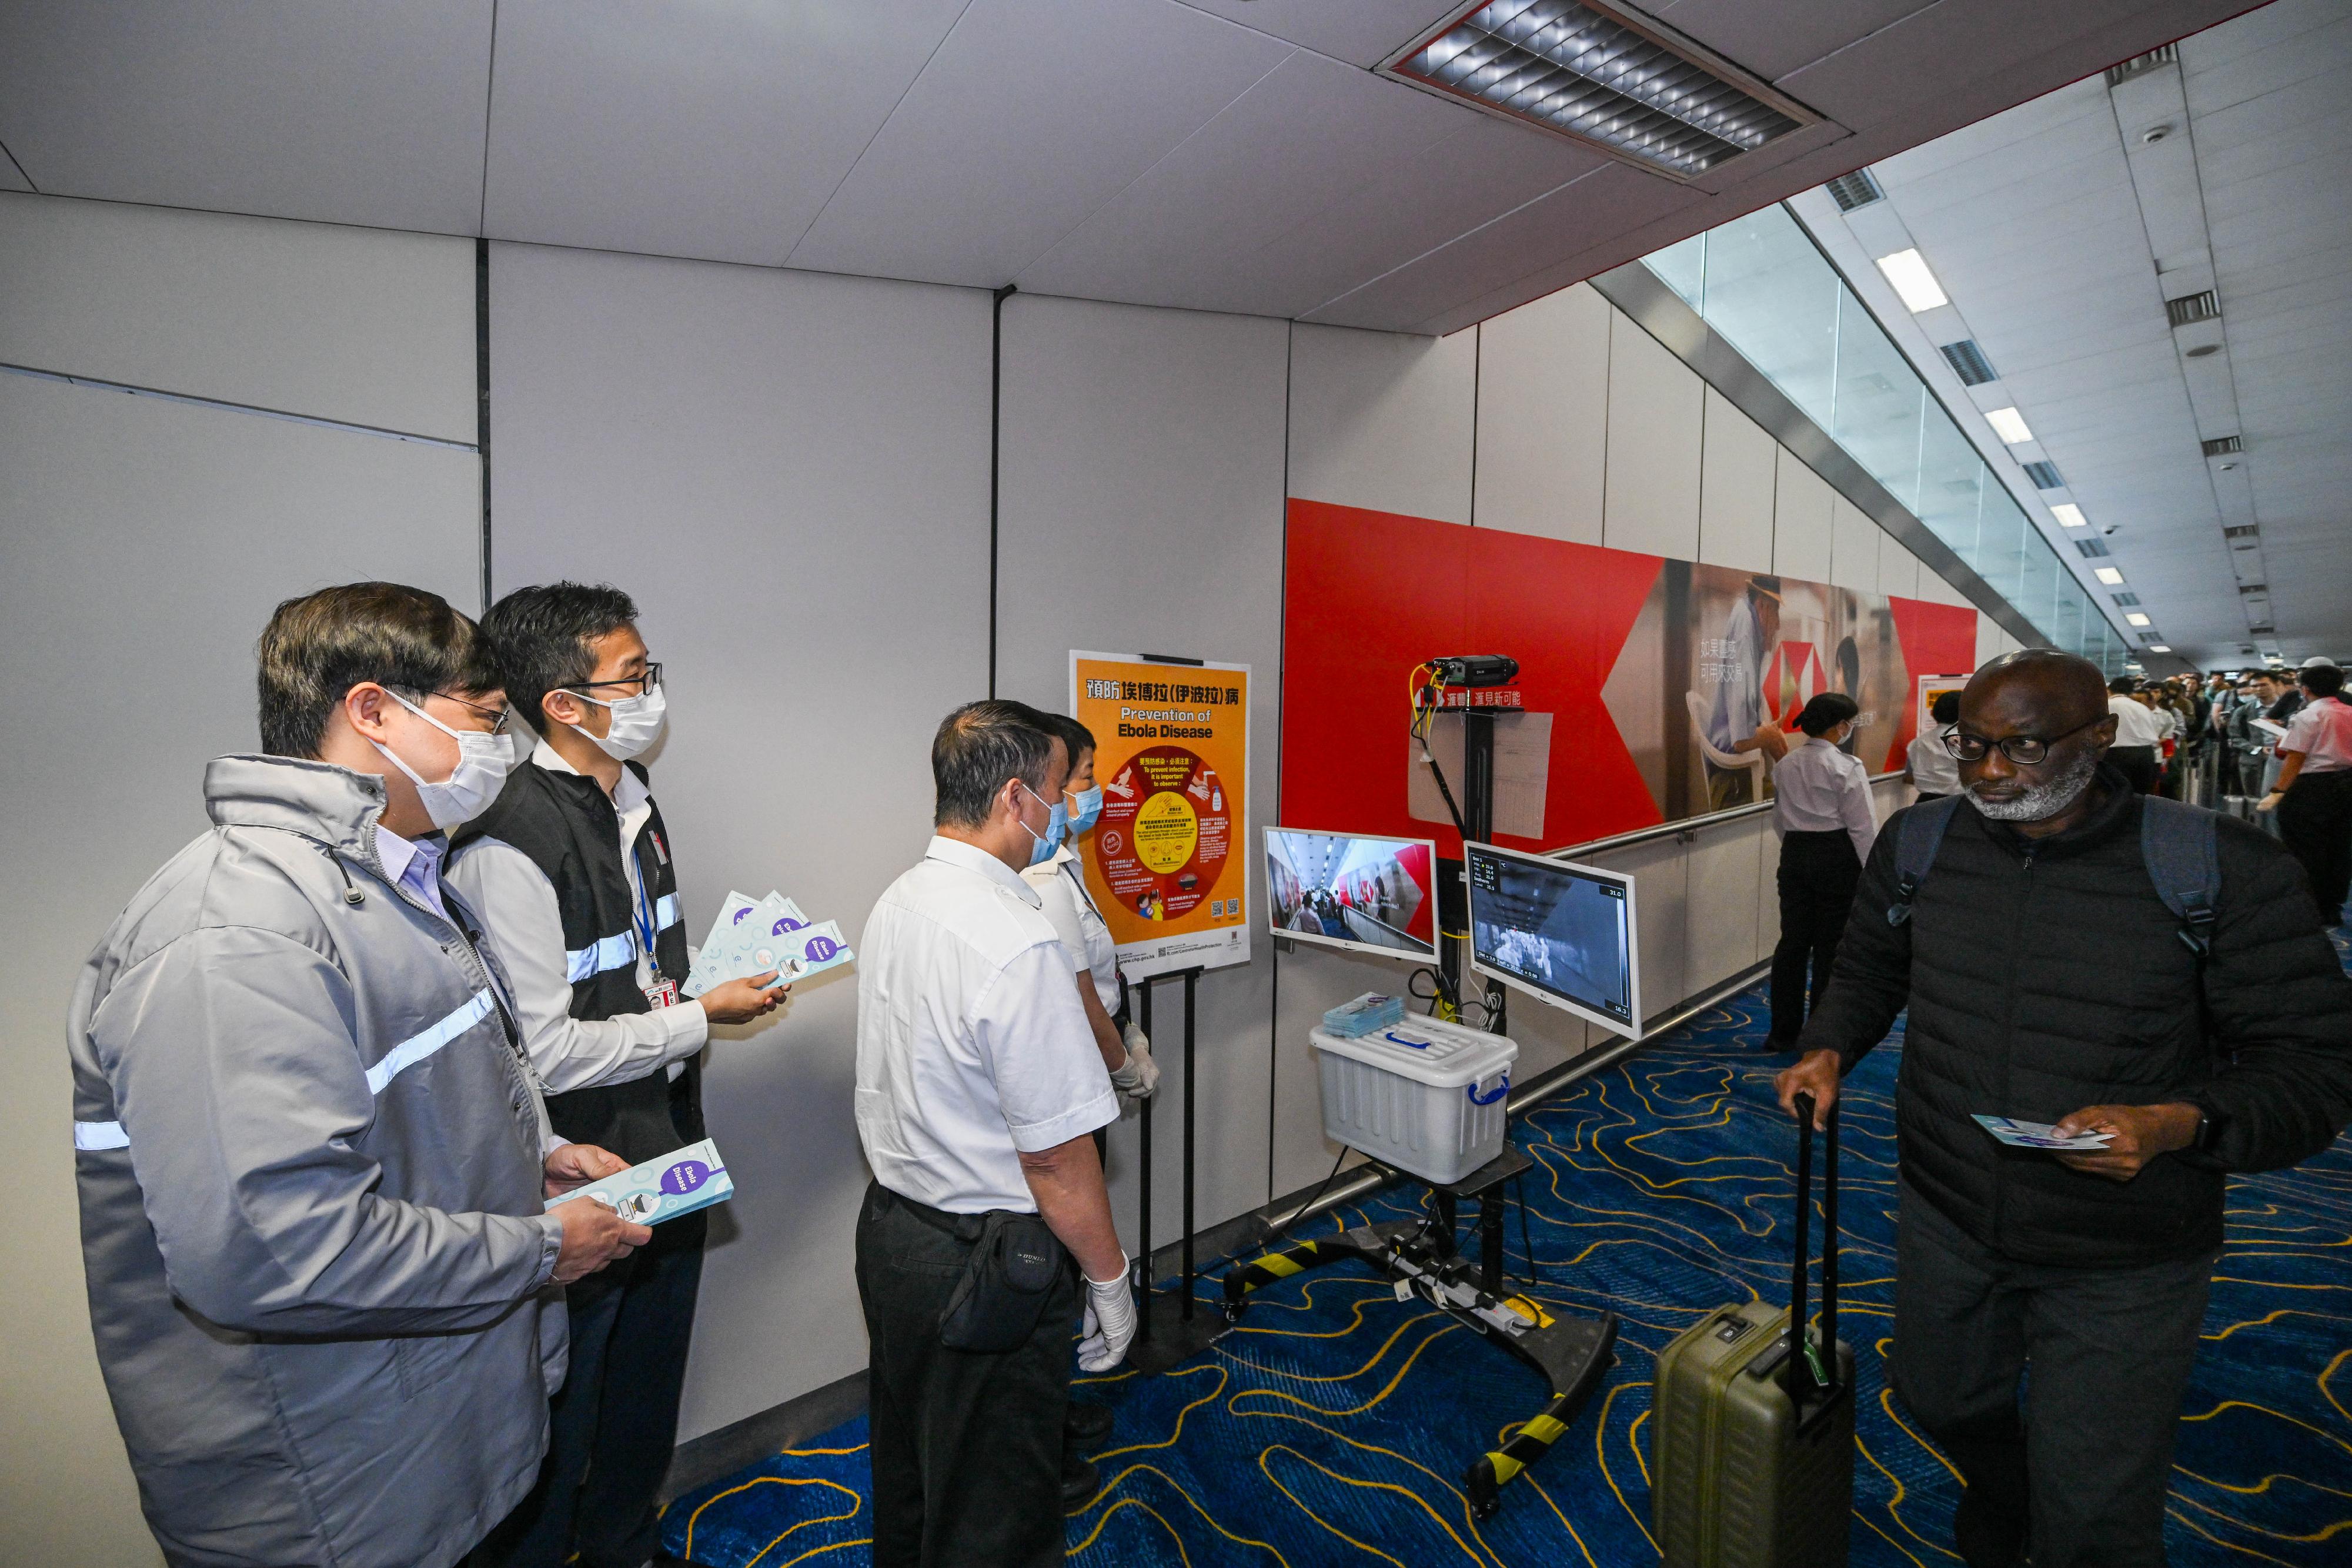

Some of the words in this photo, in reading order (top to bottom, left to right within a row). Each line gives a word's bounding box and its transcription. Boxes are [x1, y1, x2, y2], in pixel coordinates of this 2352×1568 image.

[1700, 663, 1742, 683] 可用來交易
[1121, 707, 1194, 721] Prevention
[1198, 710, 1211, 722] of
[1118, 724, 1157, 738] Ebola
[1160, 724, 1213, 738] Disease
[812, 941, 824, 960] Disease
[820, 941, 829, 955] Ebola
[1615, 1006, 1627, 1014] 16.3
[673, 1166, 687, 1191] Disease
[684, 1166, 696, 1183] Ebola
